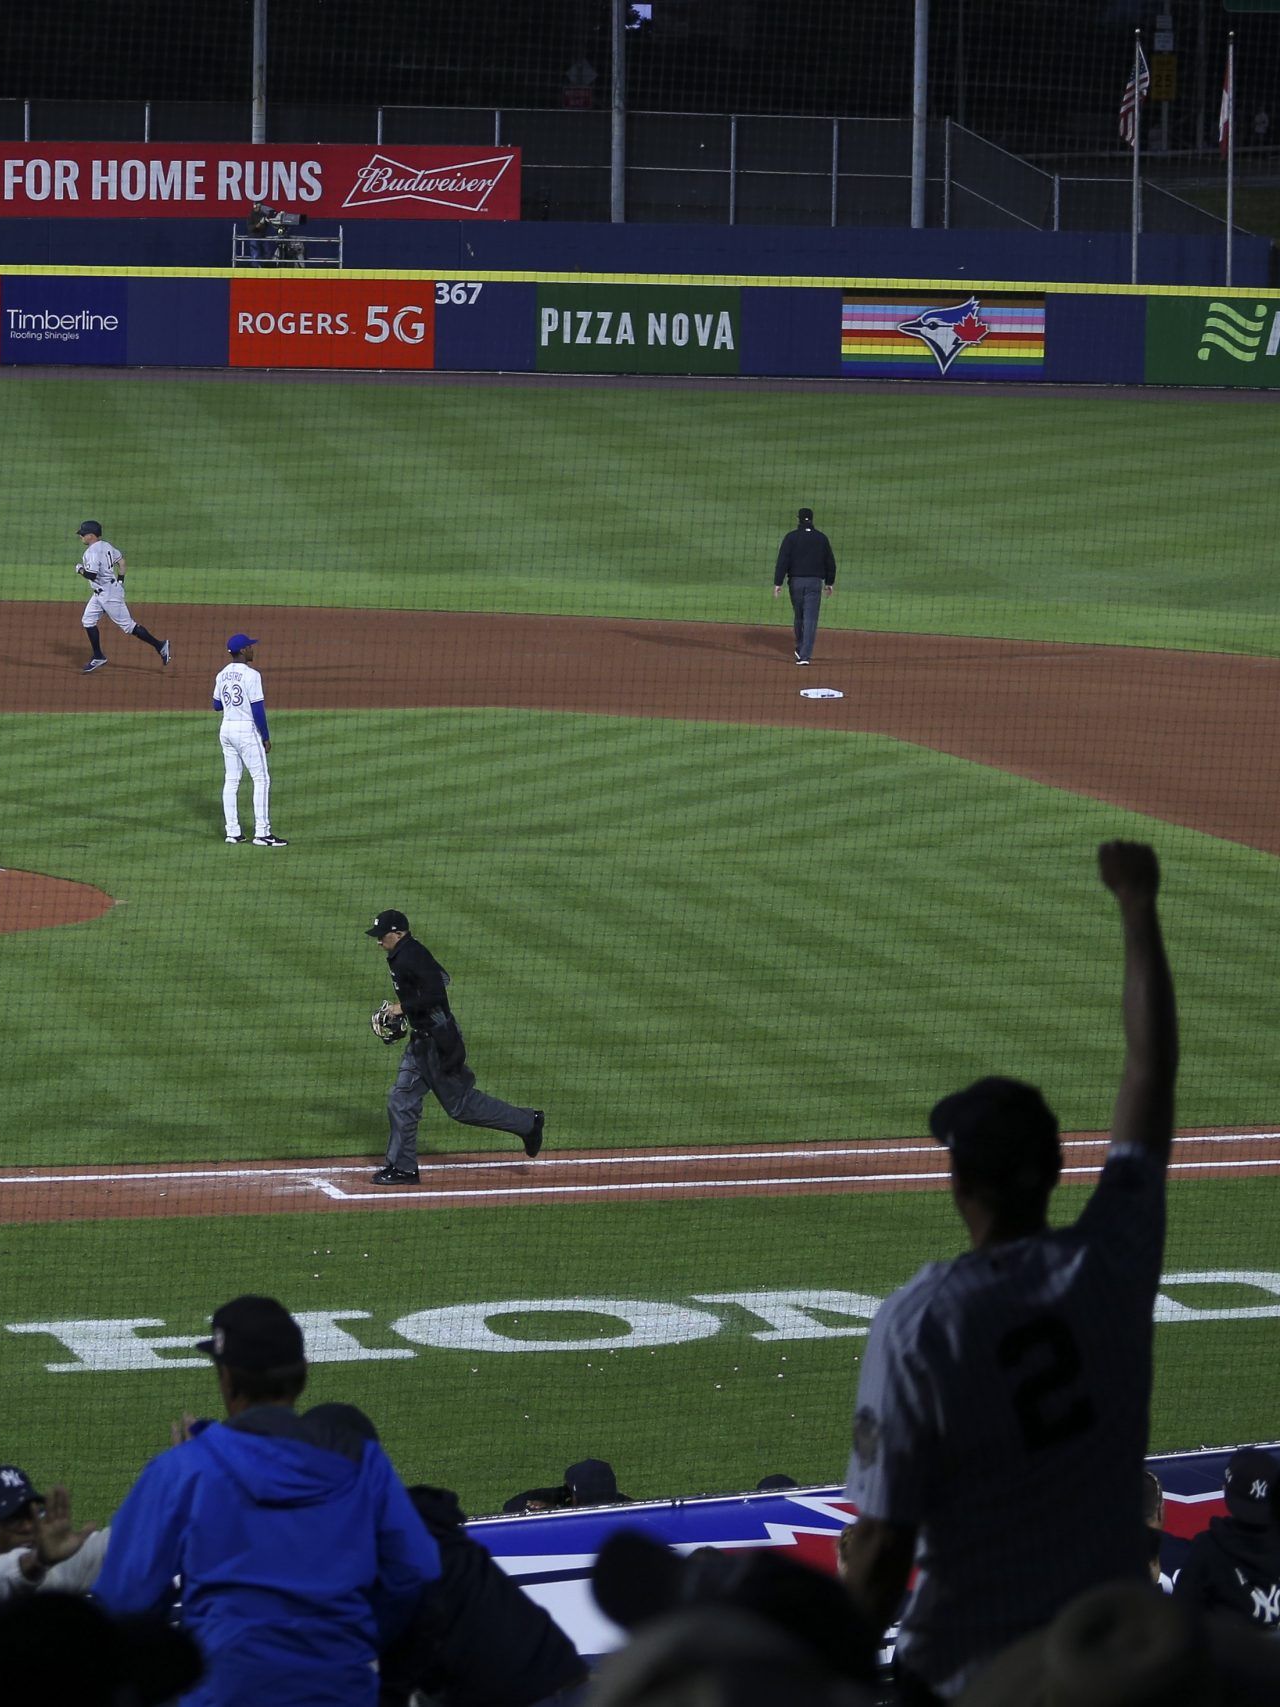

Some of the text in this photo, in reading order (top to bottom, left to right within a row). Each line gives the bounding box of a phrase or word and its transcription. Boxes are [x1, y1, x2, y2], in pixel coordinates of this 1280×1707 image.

[4, 159, 79, 200] FOR
[92, 160, 206, 201] HOME
[218, 160, 323, 201] RUNS
[357, 167, 495, 193] Budweiser
[434, 282, 483, 305] 367
[6, 309, 119, 331] Timberline
[238, 305, 425, 344] ROGERS 5G
[540, 307, 735, 350] PIZZA NOVA
[10, 330, 80, 342] Roofing Shingles
[222, 684, 243, 707] 63
[997, 1316, 1098, 1450] 2
[1250, 1479, 1269, 1498] NY
